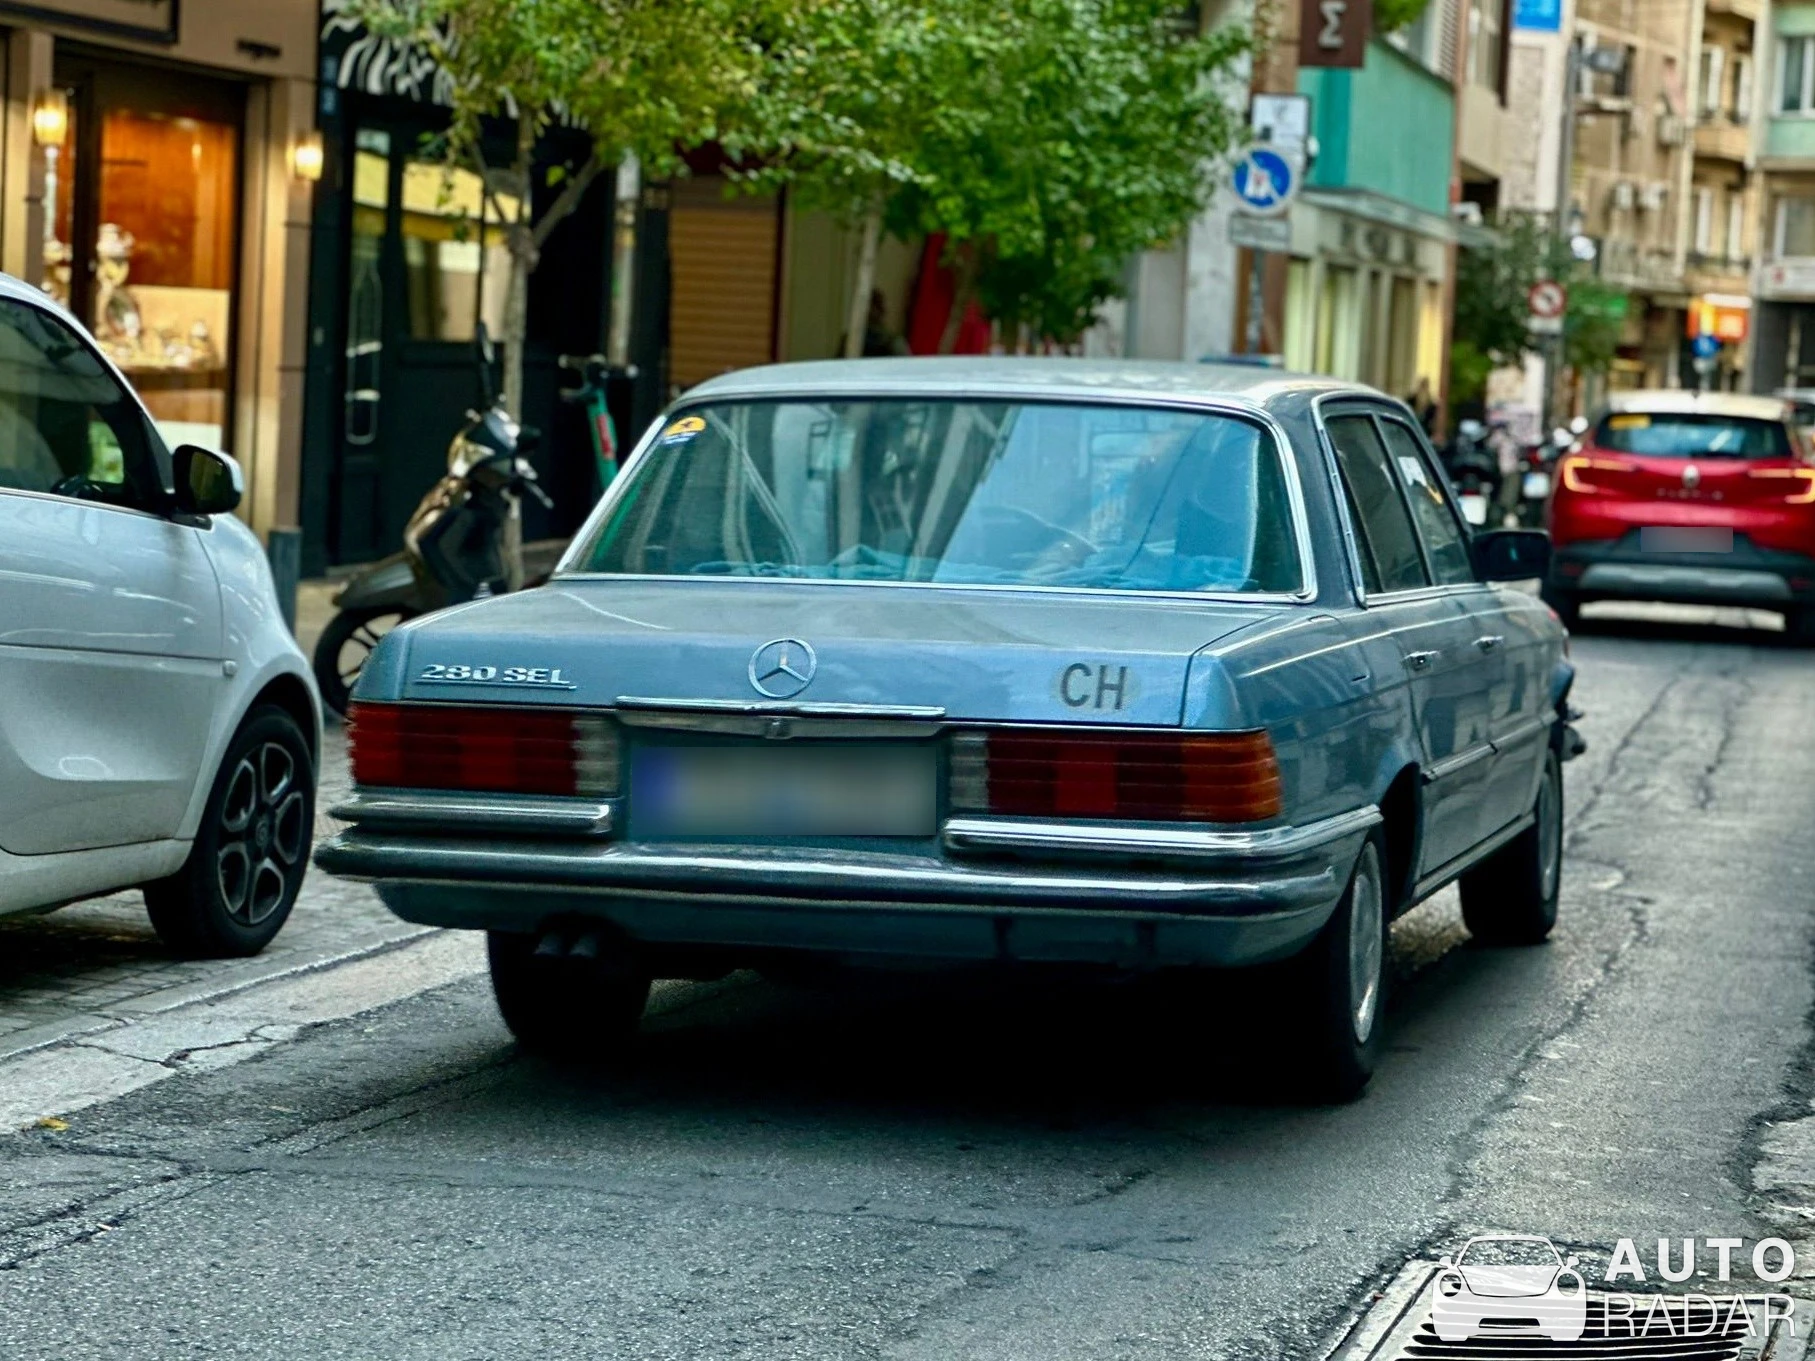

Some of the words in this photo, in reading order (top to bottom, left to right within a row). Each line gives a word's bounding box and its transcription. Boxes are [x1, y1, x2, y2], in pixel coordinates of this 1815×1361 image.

[421, 664, 497, 681] 280
[502, 667, 571, 684] SEL
[1061, 662, 1127, 710] CH
